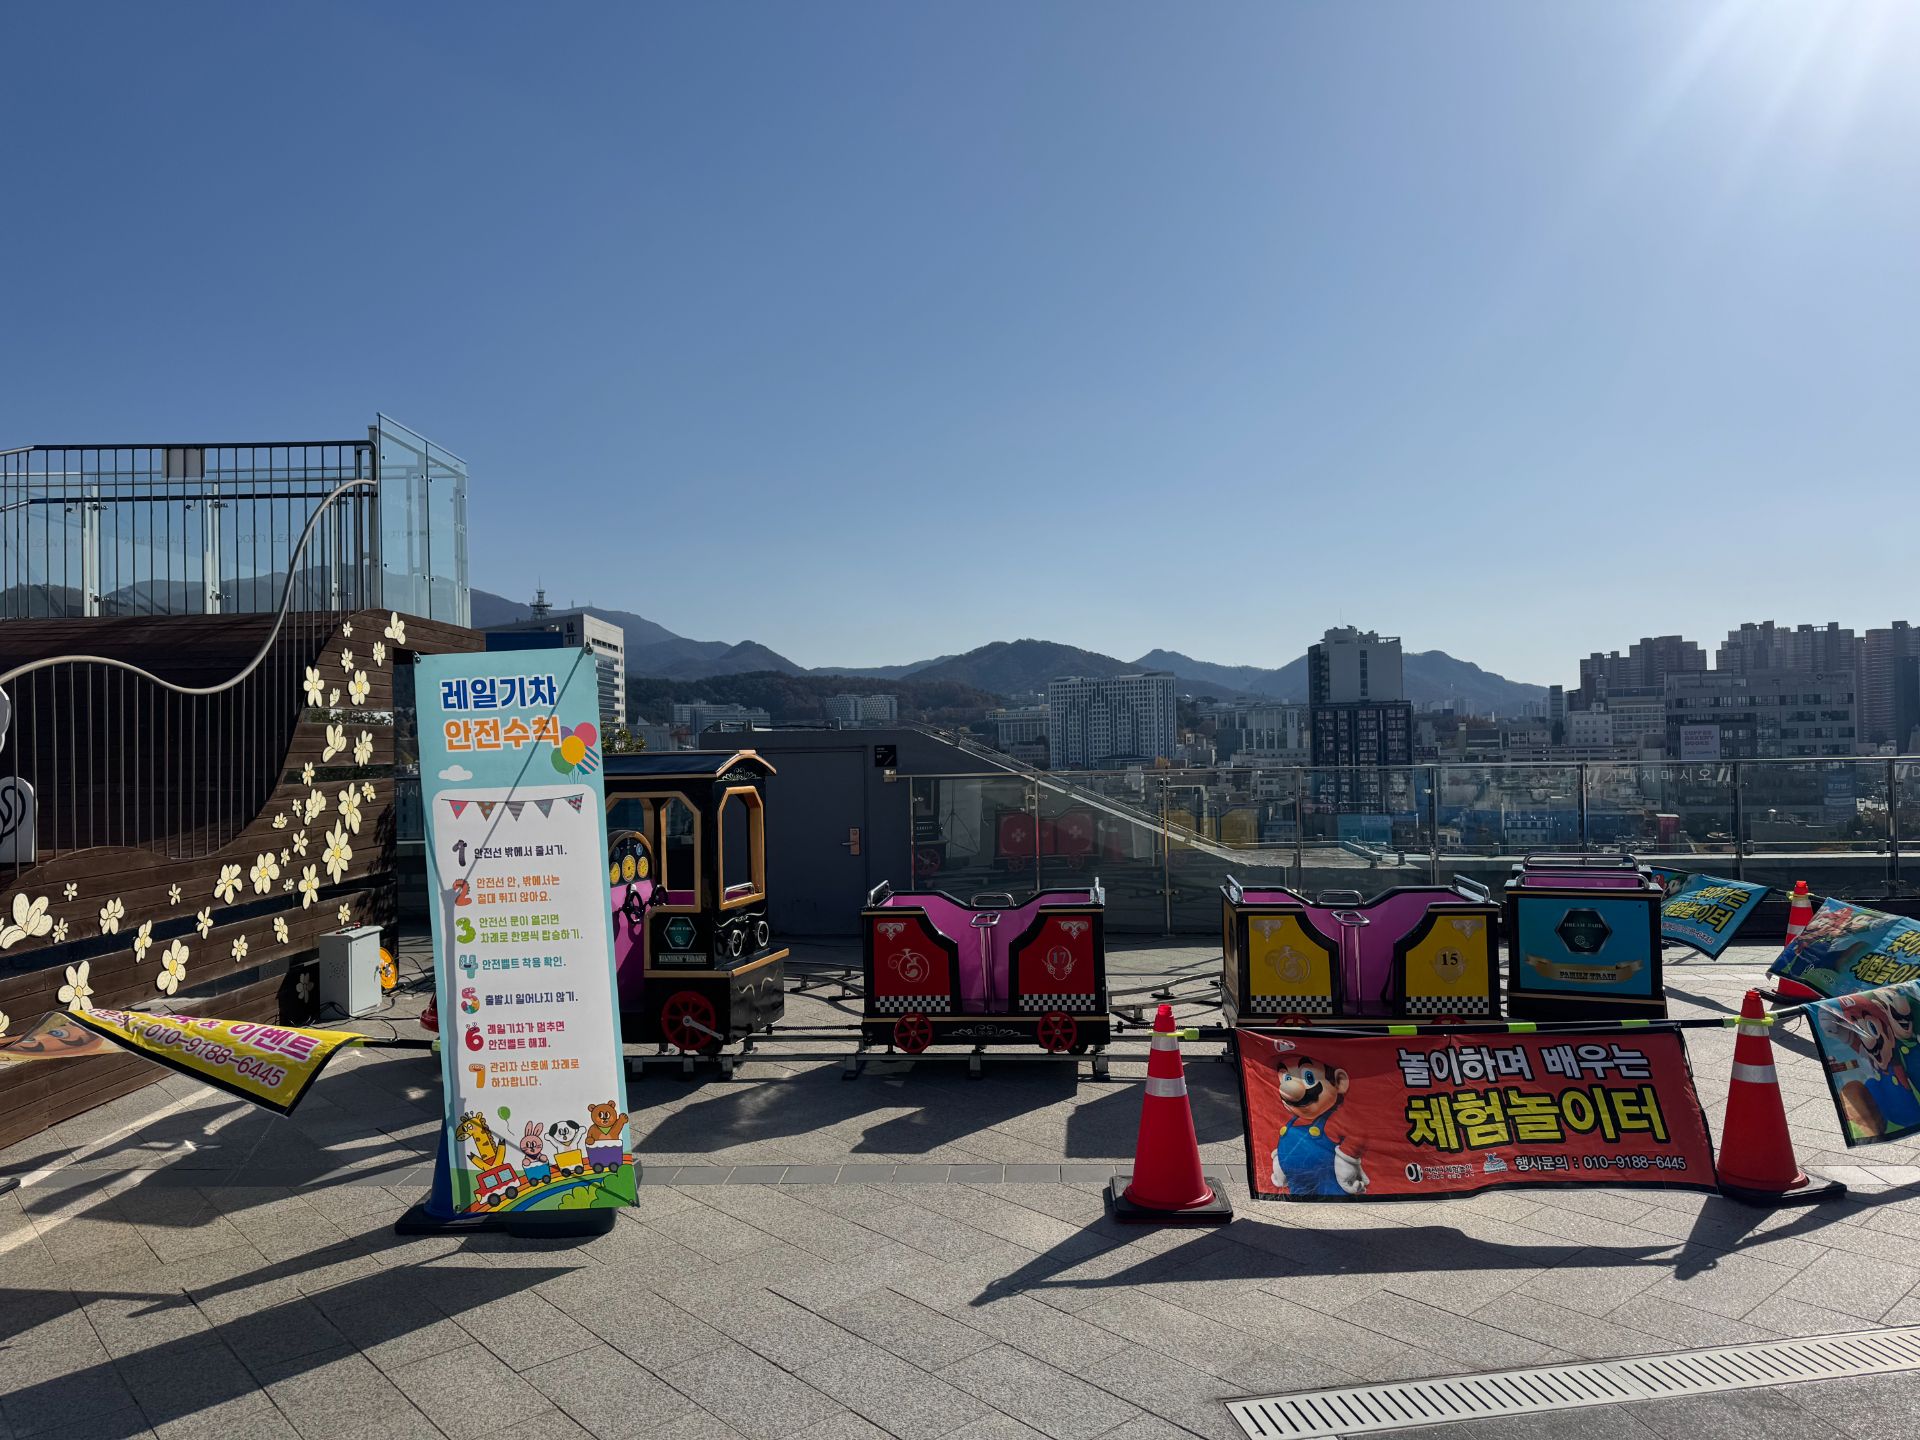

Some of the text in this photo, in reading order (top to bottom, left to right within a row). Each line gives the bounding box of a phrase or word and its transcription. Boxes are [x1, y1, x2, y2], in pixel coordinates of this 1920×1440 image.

[441, 676, 557, 709] 레일기차
[445, 715, 561, 751] 안전수칙
[452, 839, 568, 867] 1 안전선 밖에서 줄서기.
[453, 875, 560, 906] 2 안전선 안, 밖에서는
[477, 891, 552, 905] 절대 뛰지 않아요.
[456, 914, 560, 944] 3 안전선 문이 열리면
[481, 928, 583, 943] 차례로 한명씩 탑승하기.
[459, 954, 567, 979] 4 안전벨트 착용 확인.
[1052, 950, 1066, 964] 17
[1441, 952, 1458, 965] 15
[1850, 953, 1920, 985] 체험놀이
[1560, 971, 1616, 981] FAMILY TRAIN
[461, 987, 579, 1015] 5 출발시 일어나지 않기.
[229, 1023, 321, 1062] 이벤트
[465, 1020, 565, 1051] 6 레일기차가 멈추면
[488, 1037, 551, 1051] 안전벨트 해제.
[144, 1024, 286, 1088] 010-9188-6445
[1399, 1043, 1651, 1087] 놀이하며 배우는
[469, 1058, 581, 1089] 7 관리자 신호에 차례로
[491, 1076, 542, 1088] 하차합니다.
[1407, 1085, 1670, 1151] 체험놀이터
[1515, 1154, 1569, 1172] 행사문의
[1583, 1154, 1688, 1171] 010-9188-6445
